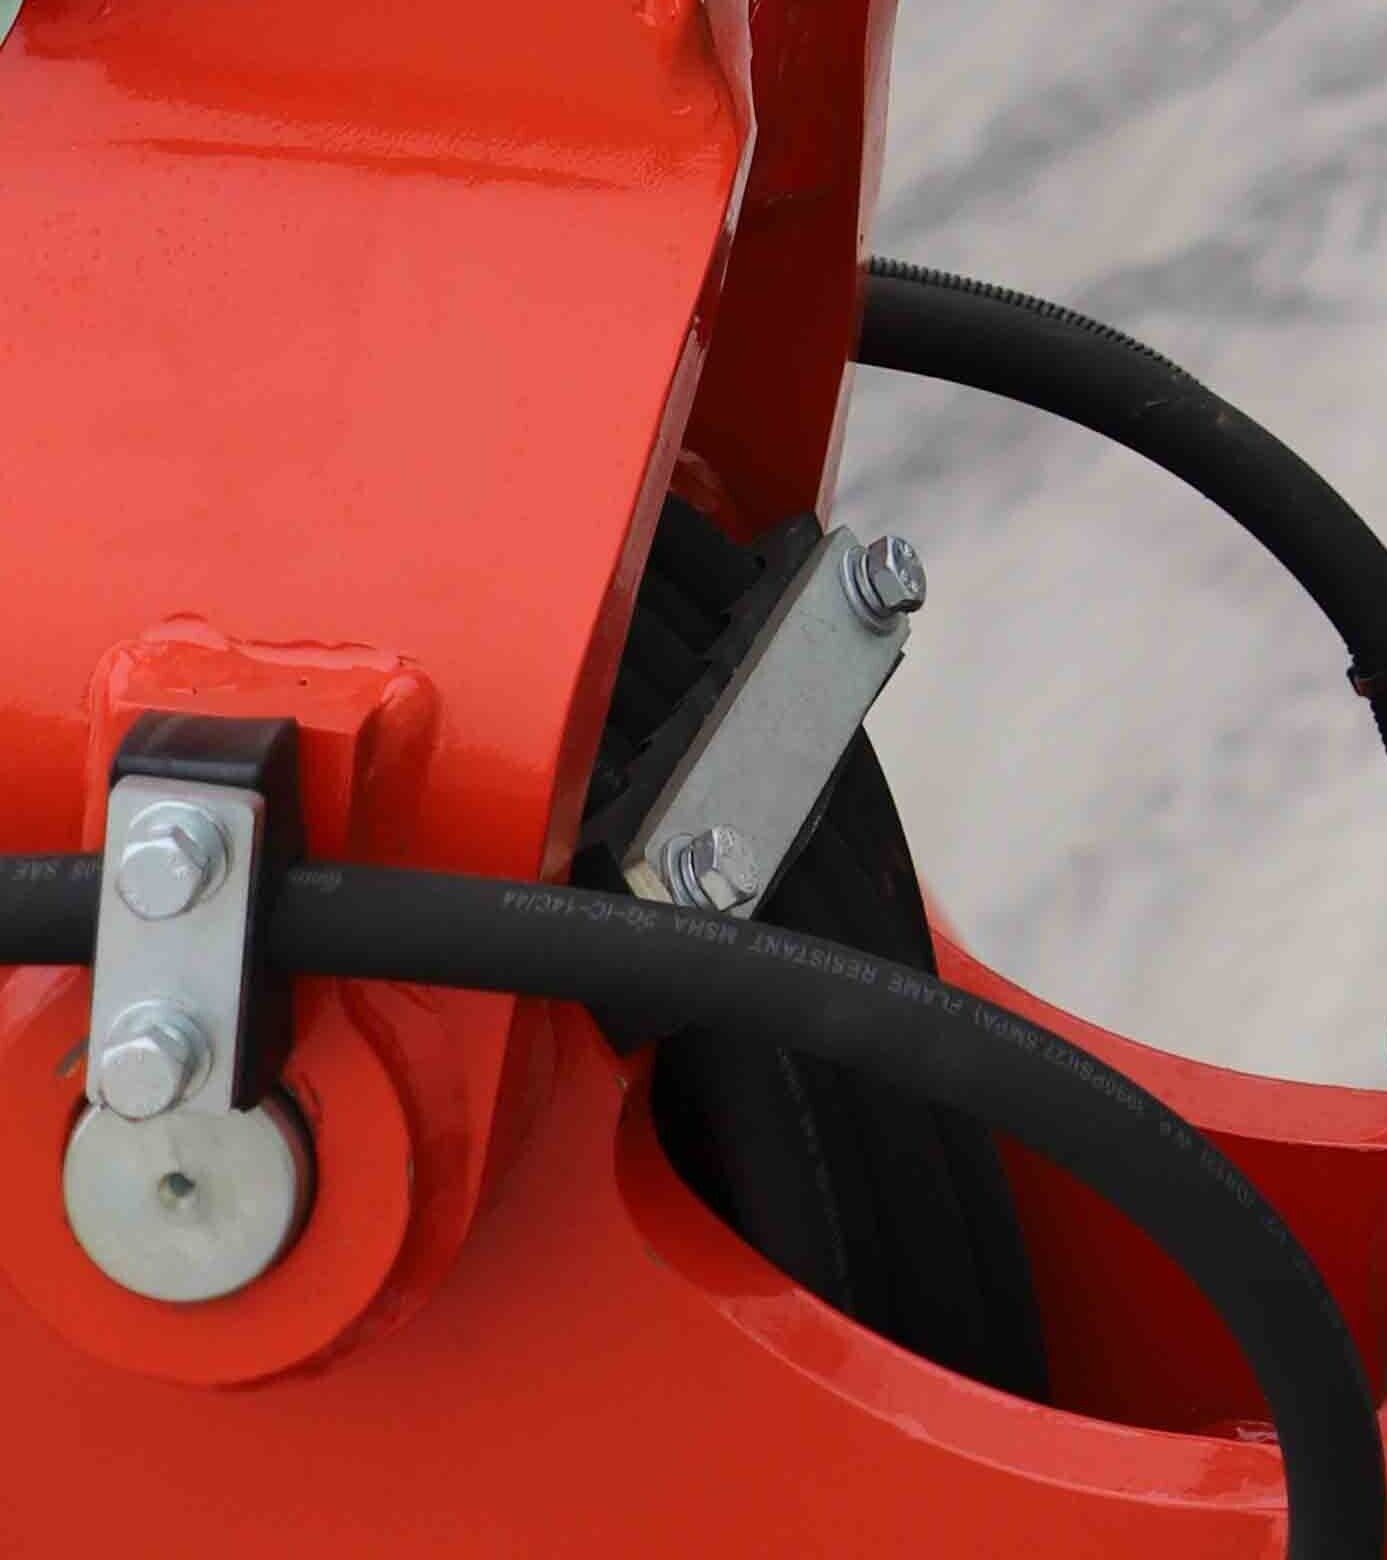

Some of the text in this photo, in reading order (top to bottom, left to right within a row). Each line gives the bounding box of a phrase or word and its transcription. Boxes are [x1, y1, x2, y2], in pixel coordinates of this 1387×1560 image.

[671, 910, 738, 948] MSHA
[748, 932, 878, 984] RESISTANT
[886, 972, 963, 1014] FLAME
